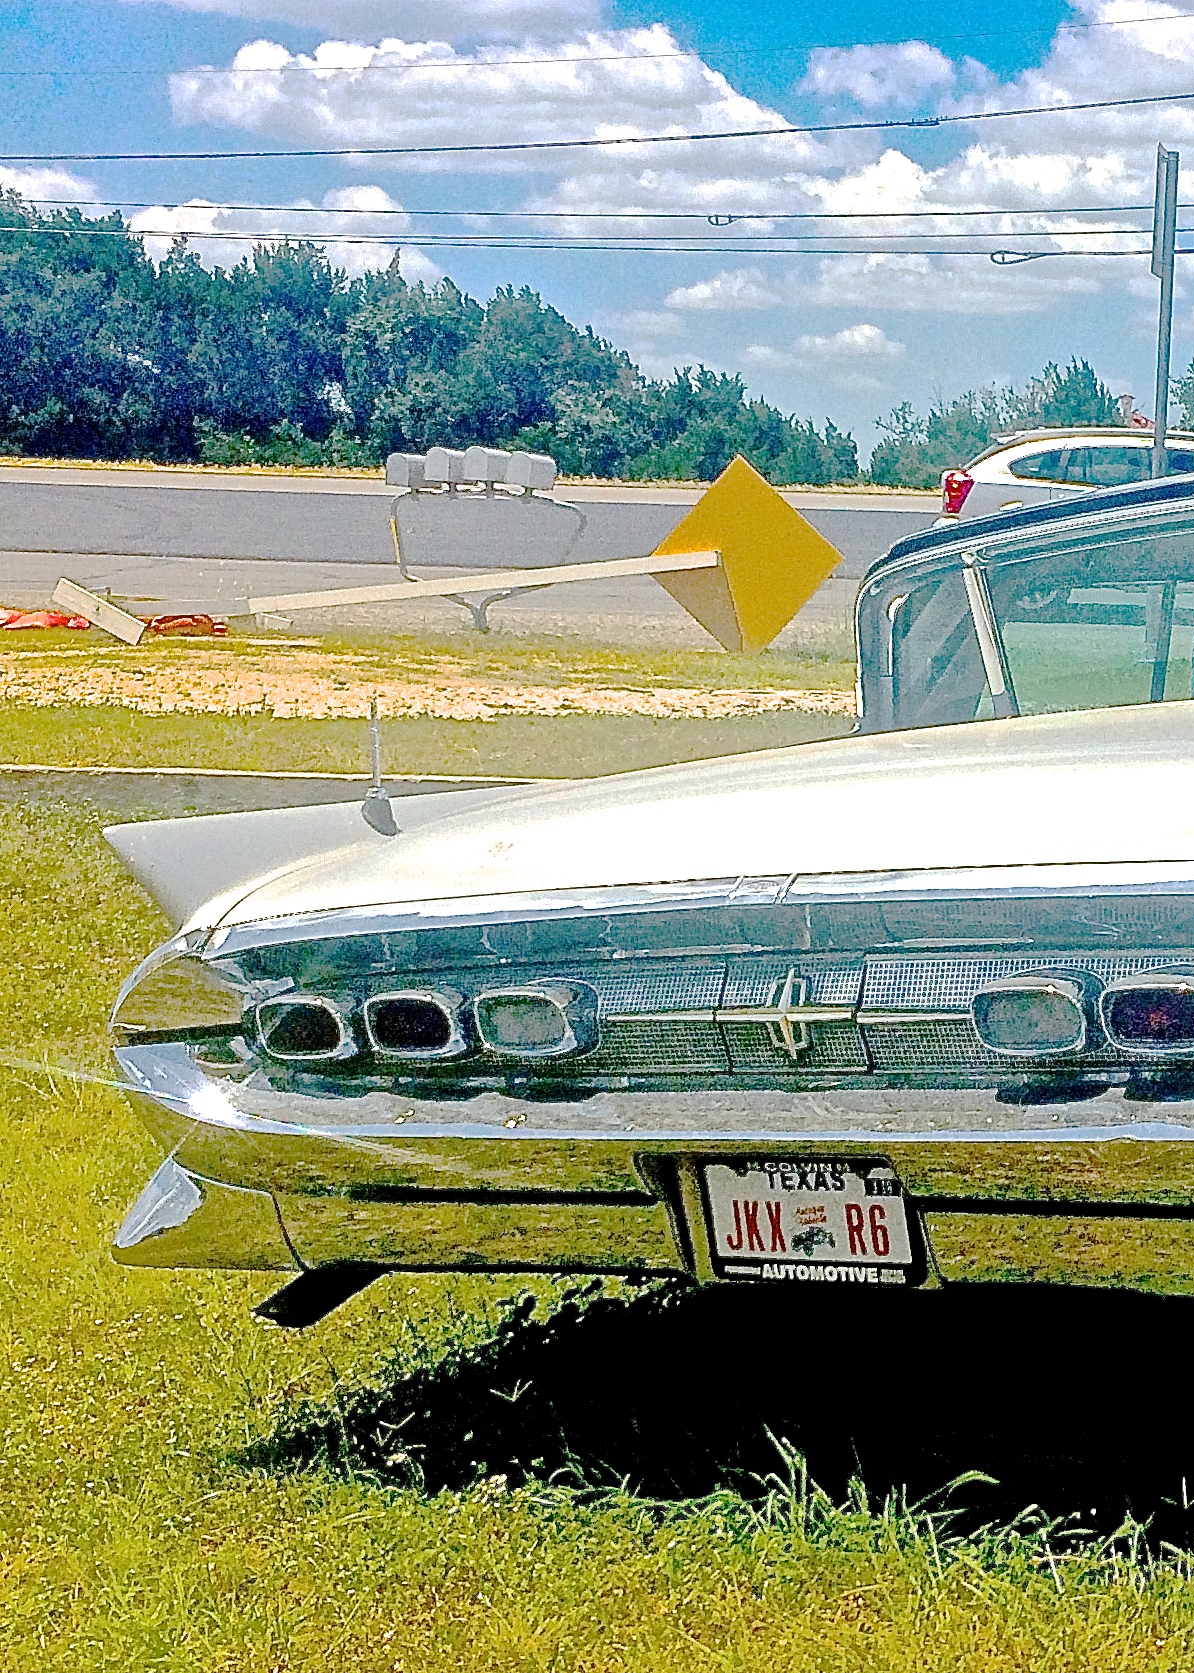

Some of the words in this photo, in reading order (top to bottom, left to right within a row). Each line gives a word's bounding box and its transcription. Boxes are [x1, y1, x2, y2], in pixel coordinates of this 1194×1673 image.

[764, 1162, 833, 1172] COLVIN
[766, 1171, 846, 1191] TEXAS
[726, 1199, 787, 1253] JKX
[844, 1203, 890, 1257] R6
[762, 1263, 879, 1283] AUTOMOTIVE
